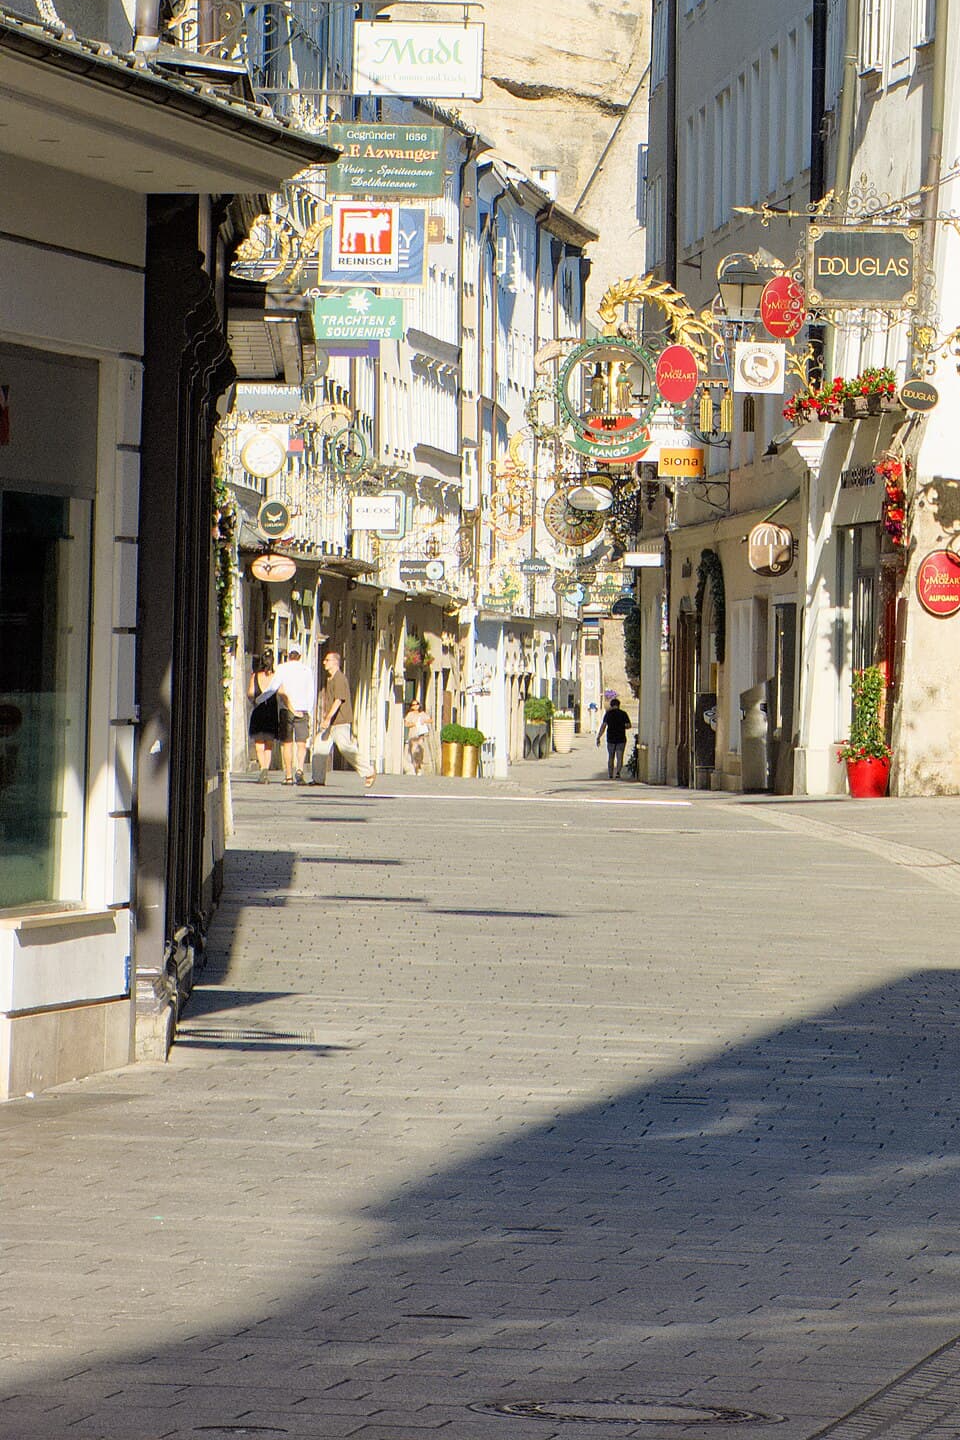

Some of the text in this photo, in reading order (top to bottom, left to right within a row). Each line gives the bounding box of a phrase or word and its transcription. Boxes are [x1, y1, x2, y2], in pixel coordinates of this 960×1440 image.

[373, 37, 463, 65] Madl
[346, 130, 396, 140] Gegründet
[364, 144, 439, 162] Azwanger
[337, 163, 365, 174] Wein
[376, 164, 435, 177] Spirituosen
[350, 176, 418, 189] Delikatessen
[338, 257, 392, 266] REINISCH
[817, 257, 909, 276] DOUGLAS
[321, 315, 397, 326] TRACHTEN &
[326, 327, 391, 338] SOUVENIRS
[664, 371, 697, 380] MOZART
[903, 389, 936, 402] DOUGLAS
[588, 445, 630, 457] MANGO
[928, 594, 959, 602] AUFGANG
